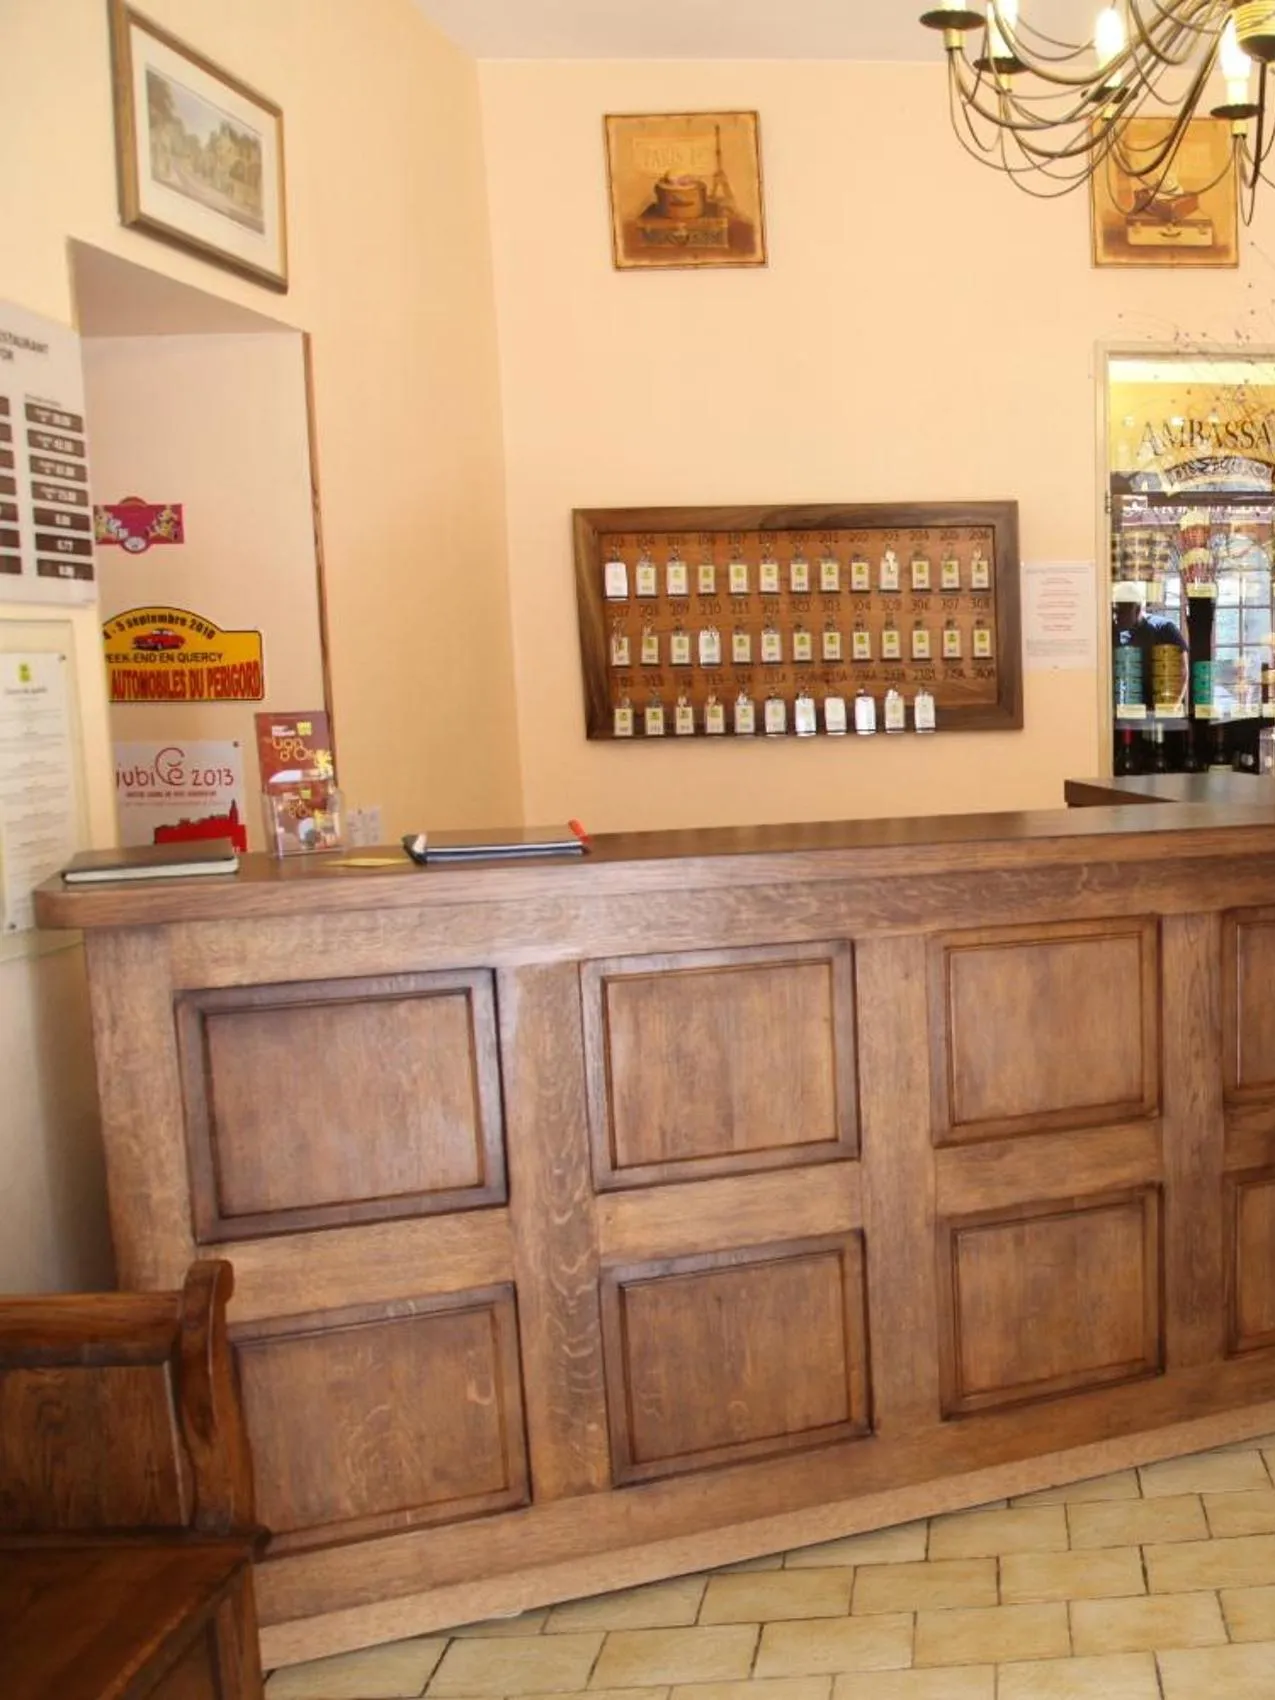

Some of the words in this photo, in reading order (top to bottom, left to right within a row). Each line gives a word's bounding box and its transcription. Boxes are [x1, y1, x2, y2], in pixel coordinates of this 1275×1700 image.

[127, 613, 187, 629] septembre
[160, 652, 175, 663] EN
[178, 652, 223, 664] QUERCY
[112, 668, 187, 699] AUTOMOBILES
[188, 667, 204, 698] DU
[192, 768, 234, 786] 2013
